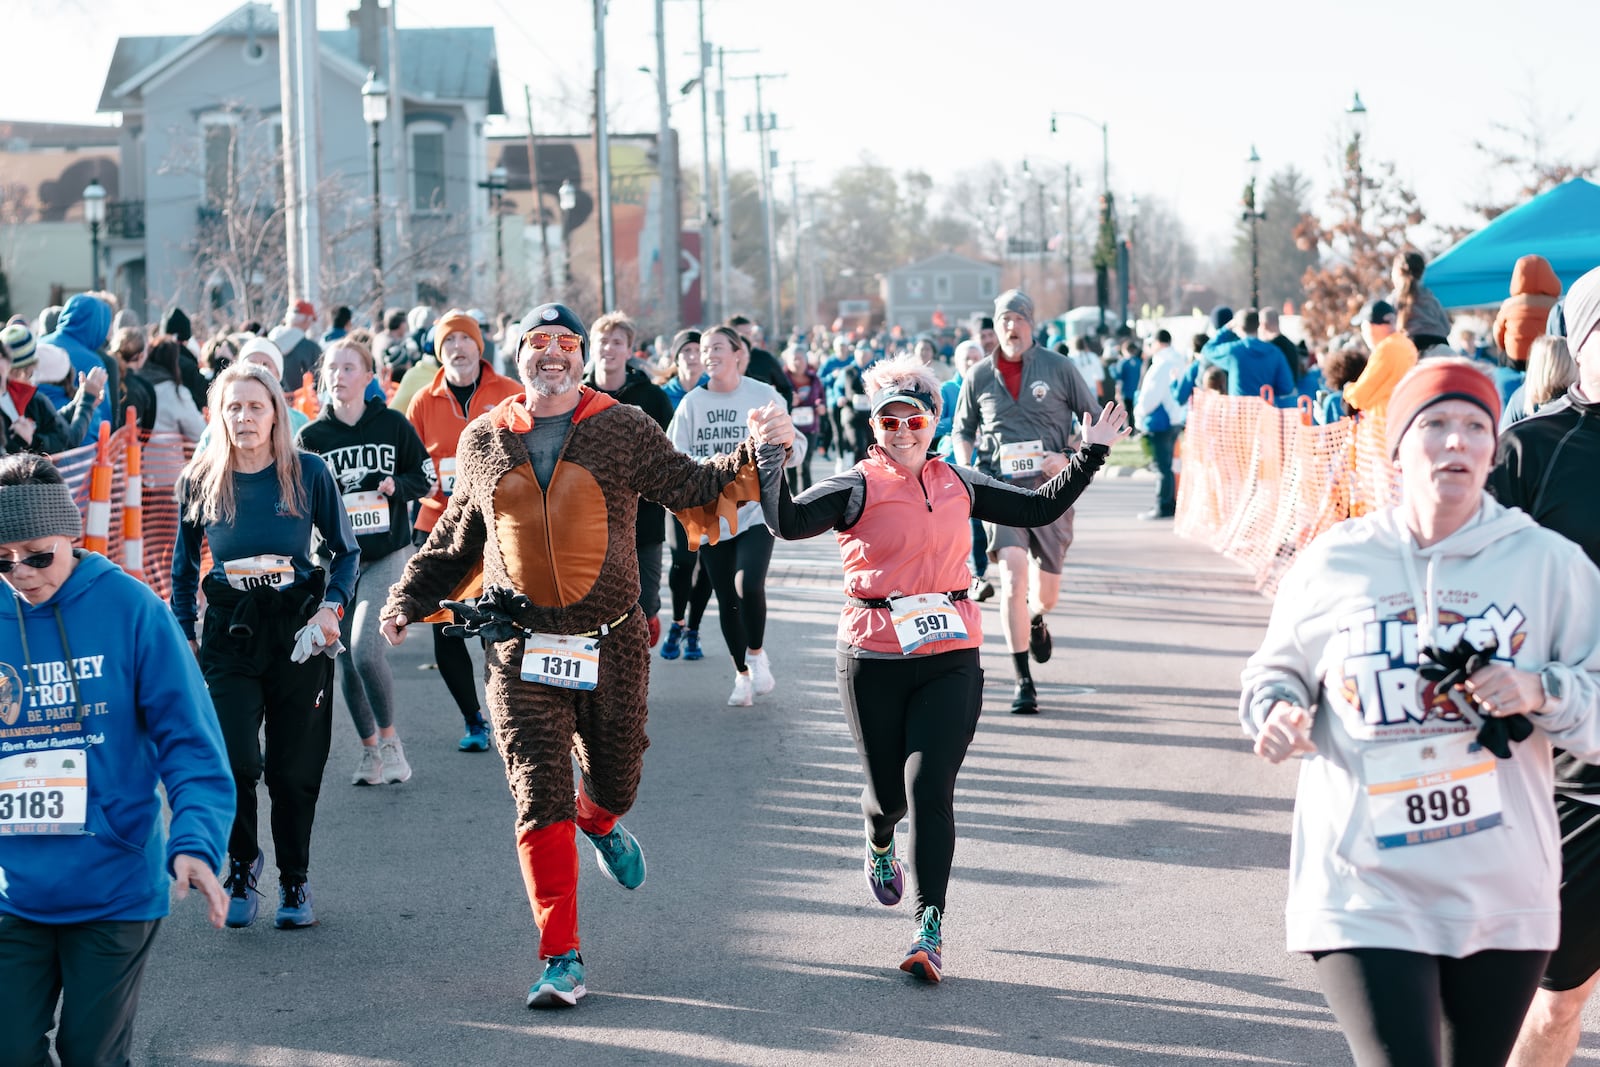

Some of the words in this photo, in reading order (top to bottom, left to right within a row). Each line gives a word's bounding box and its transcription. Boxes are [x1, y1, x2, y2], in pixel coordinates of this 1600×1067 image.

[707, 409, 737, 424] OHIO
[697, 426, 748, 441] AGAINST
[320, 444, 396, 479] WOC
[1012, 458, 1034, 471] 969
[349, 511, 381, 527] 1606
[914, 614, 948, 636] 597
[22, 654, 105, 685] TURKEY
[541, 656, 580, 678] 1311
[24, 681, 80, 707] TROT
[27, 709, 43, 723] BE
[45, 706, 74, 721] PART
[60, 722, 82, 733] OHIO
[2, 742, 25, 752] River
[26, 738, 49, 750] Road
[49, 735, 85, 749] Runners
[85, 731, 105, 745] Club
[24, 779, 46, 788] MILE
[0, 789, 64, 820] 3183
[1405, 784, 1471, 825] 898
[14, 824, 35, 833] PART
[36, 824, 49, 833] OF
